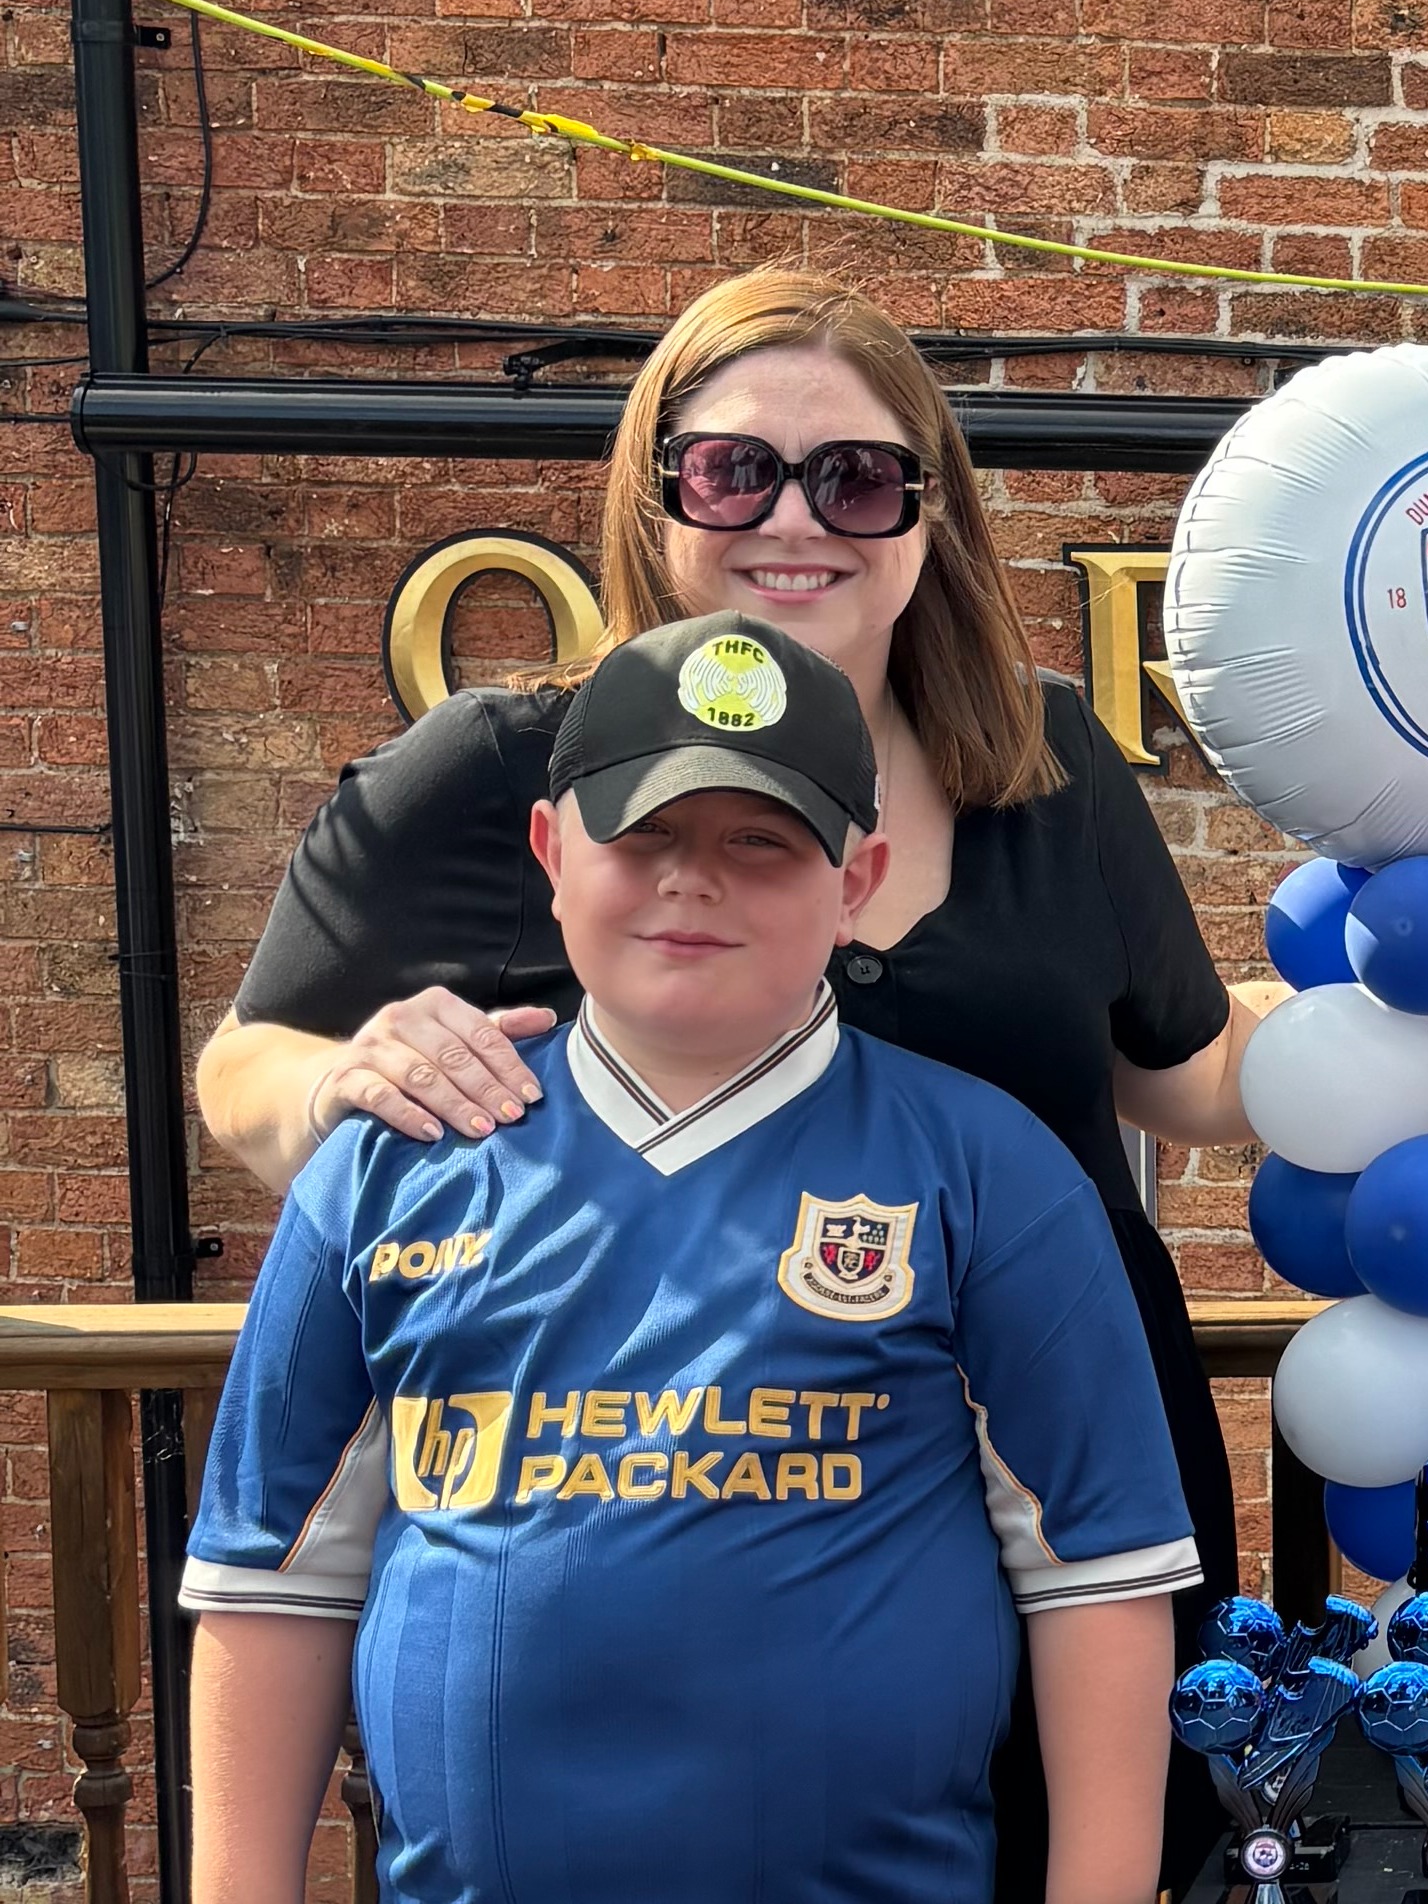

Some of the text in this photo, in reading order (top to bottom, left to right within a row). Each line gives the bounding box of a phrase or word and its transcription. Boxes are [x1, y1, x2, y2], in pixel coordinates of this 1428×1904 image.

[1386, 588, 1408, 610] 18
[712, 640, 765, 664] THFC
[707, 706, 755, 727] 1882
[368, 1228, 494, 1284] PONY
[525, 1386, 877, 1440] HEWLETT
[417, 1397, 476, 1511] hp
[514, 1450, 863, 1506] PACKARD
